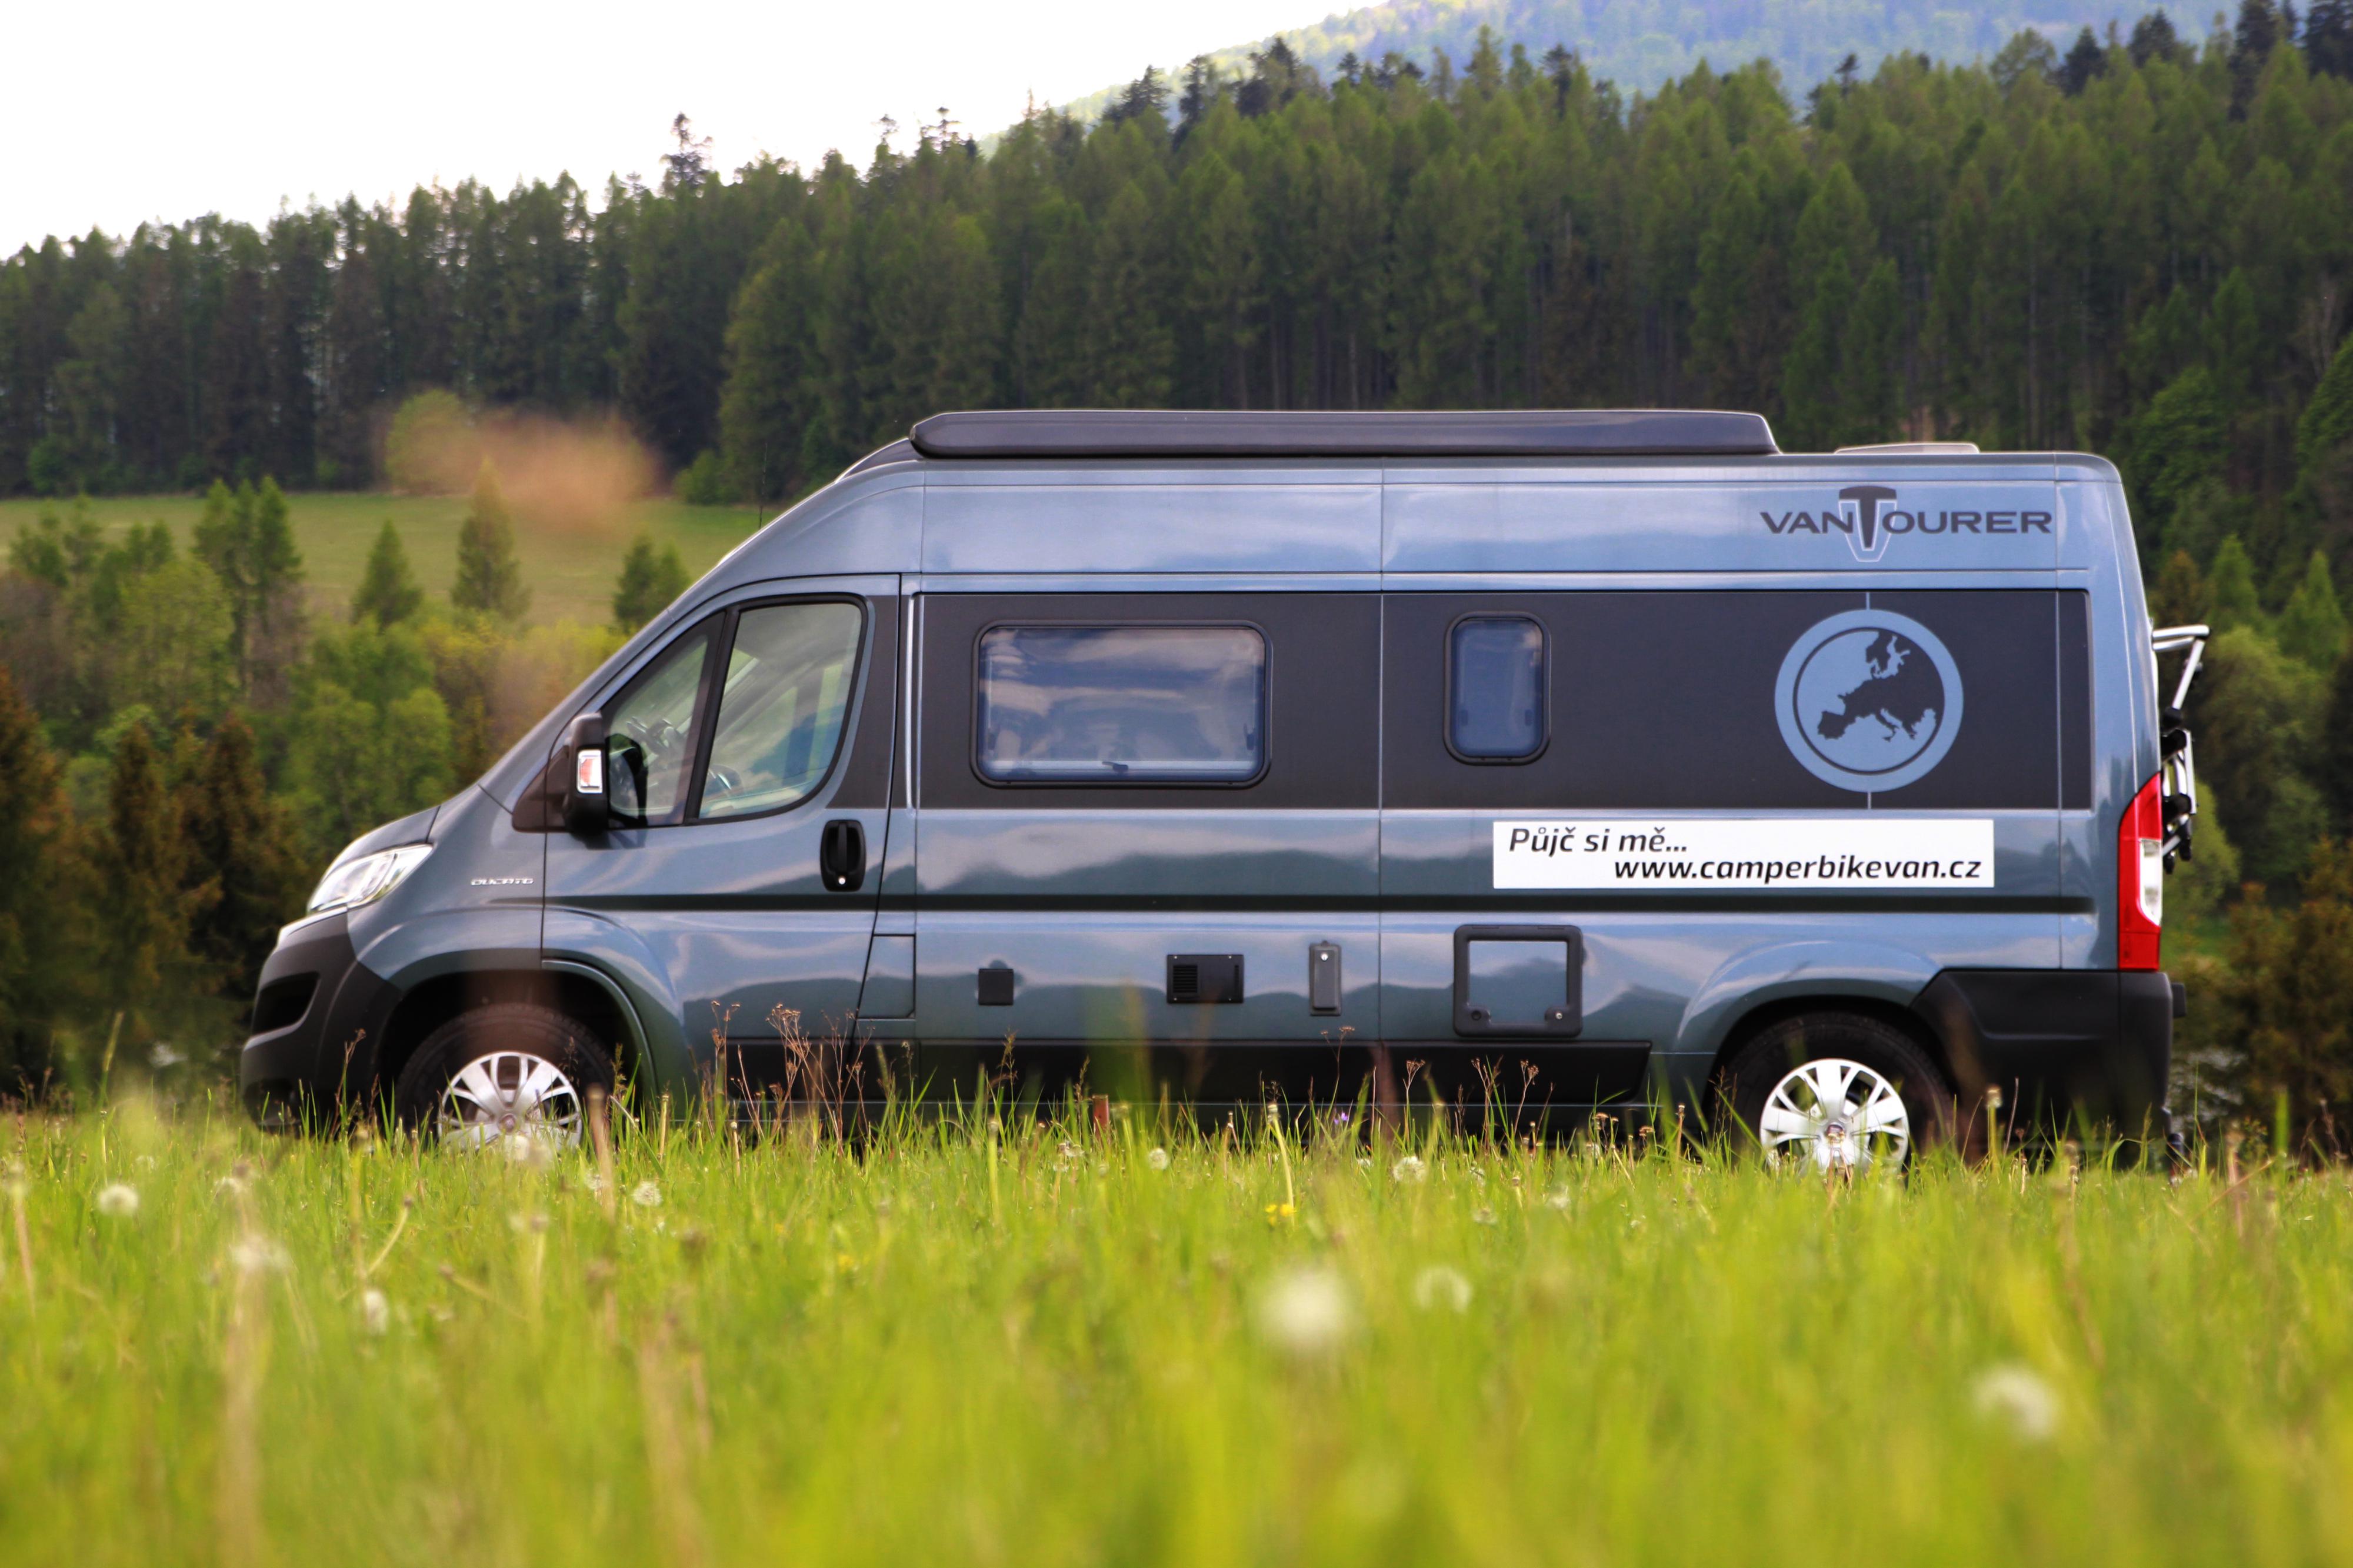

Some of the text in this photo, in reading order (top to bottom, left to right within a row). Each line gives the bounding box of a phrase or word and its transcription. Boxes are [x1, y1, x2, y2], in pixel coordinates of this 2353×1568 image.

[1759, 486, 2052, 549] VANTOURER
[1509, 826, 1688, 858] Půjč si mě...
[1614, 855, 1982, 885] www.camperbikevan.cz
